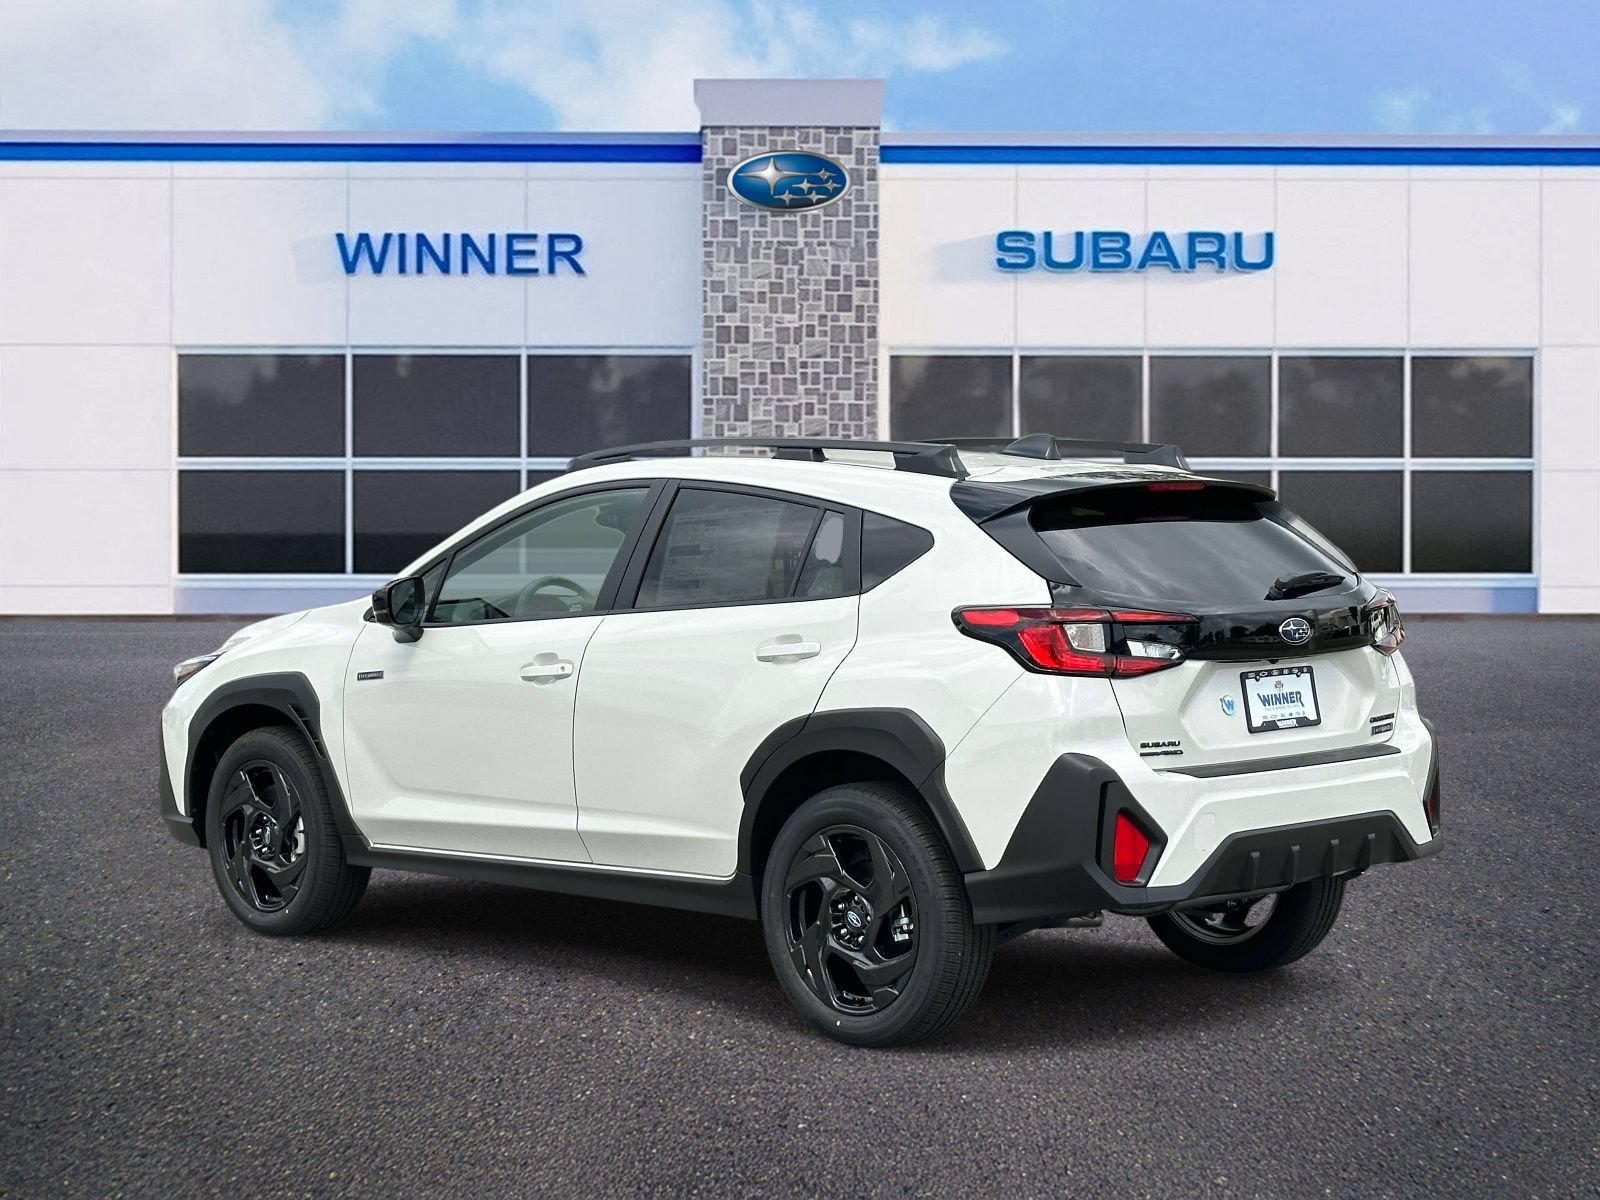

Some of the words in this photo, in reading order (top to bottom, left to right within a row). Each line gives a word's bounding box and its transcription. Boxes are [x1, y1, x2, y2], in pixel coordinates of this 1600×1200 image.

[335, 232, 586, 275] WINNER
[996, 231, 1274, 271] SUBARU
[1257, 691, 1305, 707] WINNER
[1140, 740, 1181, 748] SUBARU
